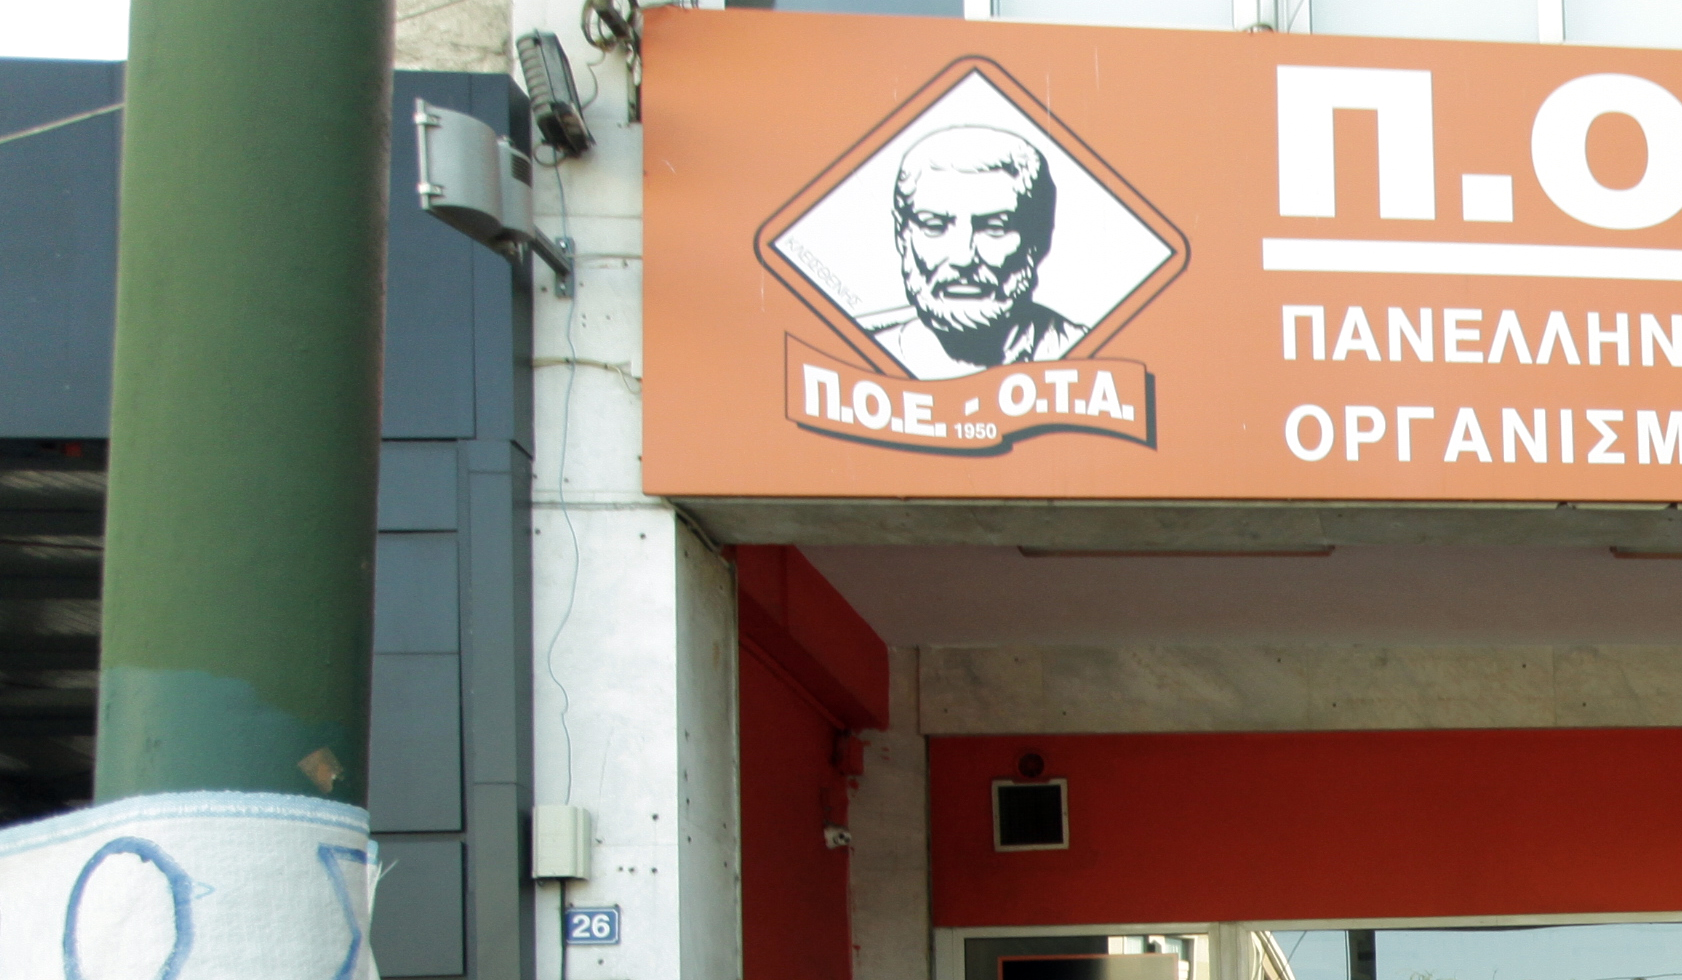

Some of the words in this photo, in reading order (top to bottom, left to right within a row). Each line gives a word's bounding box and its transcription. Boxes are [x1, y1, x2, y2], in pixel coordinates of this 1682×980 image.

[802, 362, 948, 438] Π.Ο.Ε.
[998, 368, 1135, 422] Ο.Τ.Α.
[954, 422, 998, 440] 1950
[572, 915, 611, 938] 26
